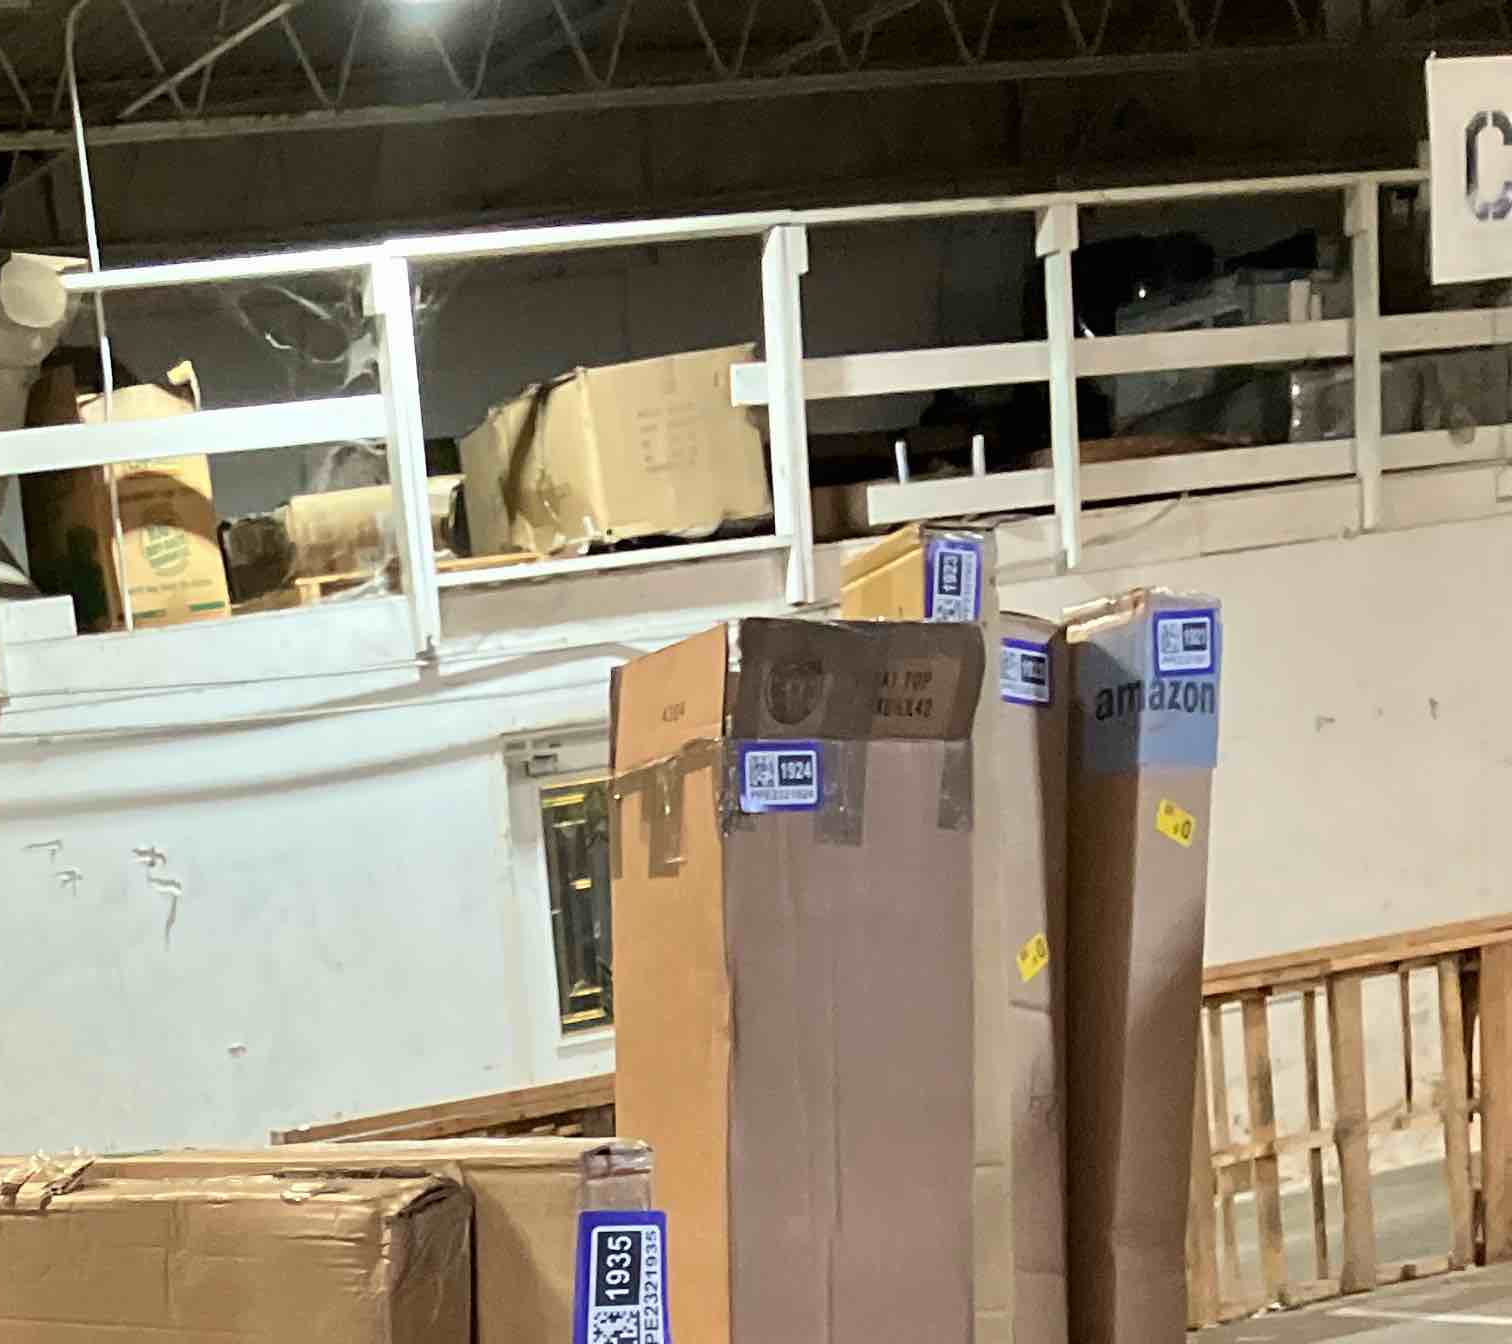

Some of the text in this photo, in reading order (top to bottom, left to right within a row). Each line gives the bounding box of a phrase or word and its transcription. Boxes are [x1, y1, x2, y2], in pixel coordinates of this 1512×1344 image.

[1095, 679, 1215, 721] amazon
[780, 760, 813, 783] 1924
[604, 1235, 633, 1301] 1935
